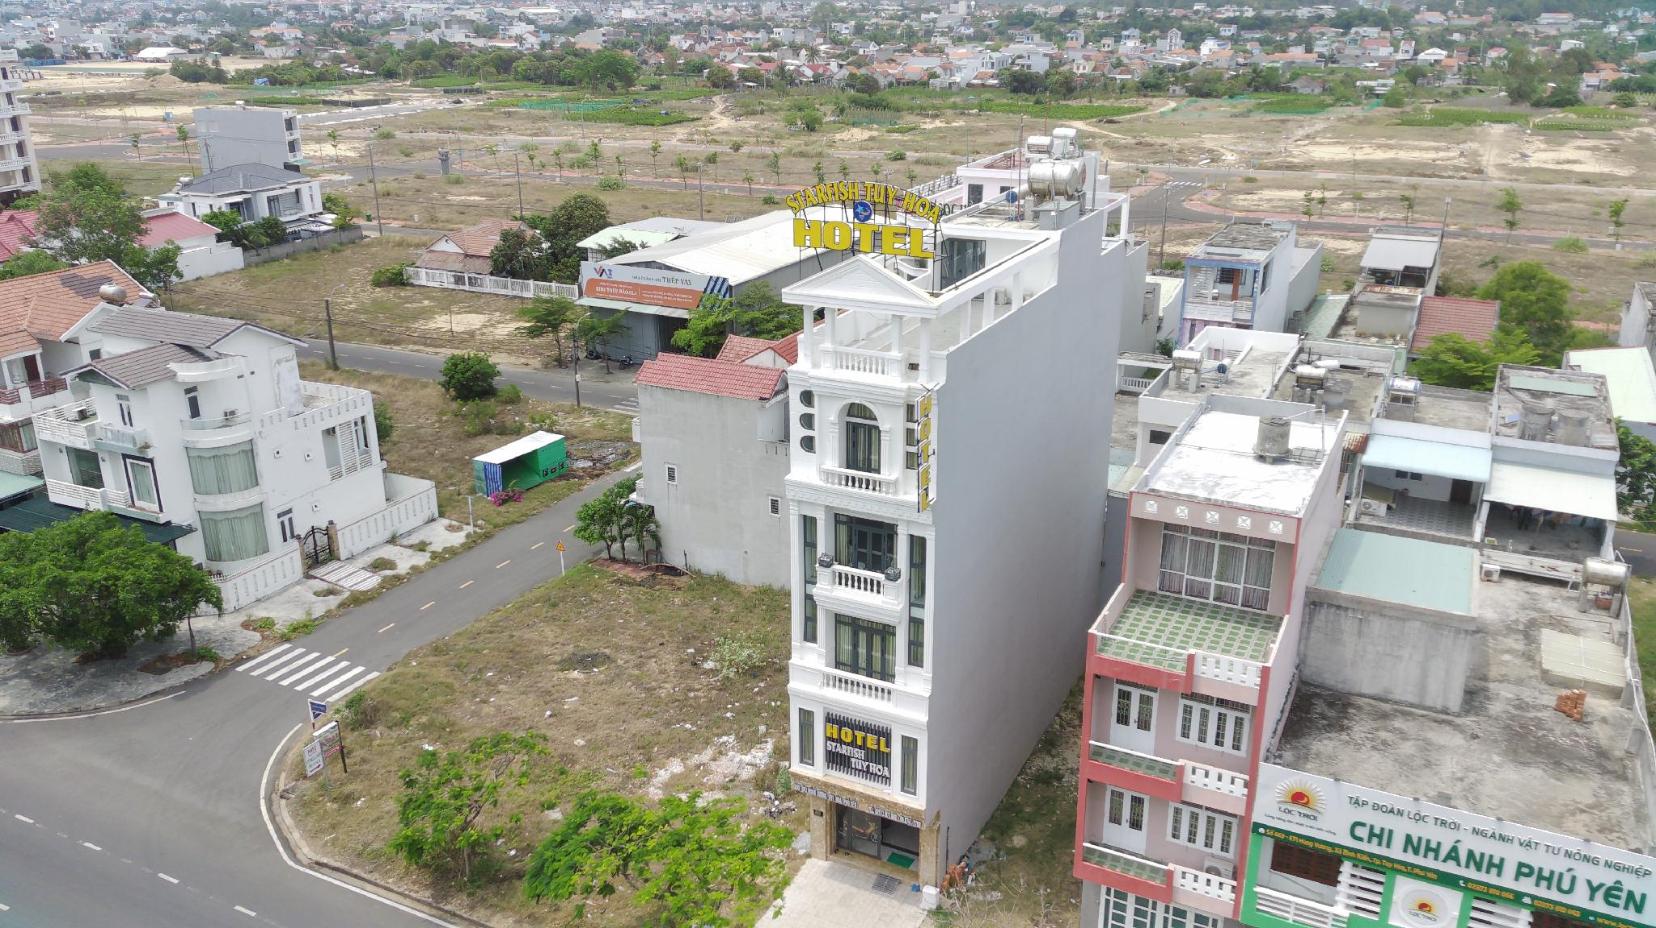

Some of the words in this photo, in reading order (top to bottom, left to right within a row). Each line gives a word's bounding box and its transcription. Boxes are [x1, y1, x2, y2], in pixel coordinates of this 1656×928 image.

[785, 180, 859, 215] STARFISH
[865, 181, 897, 205] TUY
[902, 192, 941, 225] HOA
[793, 218, 935, 259] HOTEL
[826, 723, 891, 753] HOTEL
[826, 740, 865, 760] STARFISH
[851, 757, 869, 772] TUY
[869, 762, 891, 778] HOA
[1347, 796, 1369, 809] TẬP
[1371, 803, 1405, 817] ĐOÀN
[1407, 809, 1430, 824] LỘC
[1433, 816, 1461, 831] TRỜI
[1472, 826, 1514, 845] NGÀNH
[1518, 837, 1541, 851] VẬT
[1543, 843, 1562, 856] TƯ
[1563, 849, 1601, 866] NÔNG
[1603, 859, 1653, 879] NGHIỆP
[1349, 820, 1394, 849] CHI
[1402, 833, 1505, 878] NHÁNH
[1514, 861, 1577, 895] PHÚ
[1585, 879, 1647, 914] YÊN
